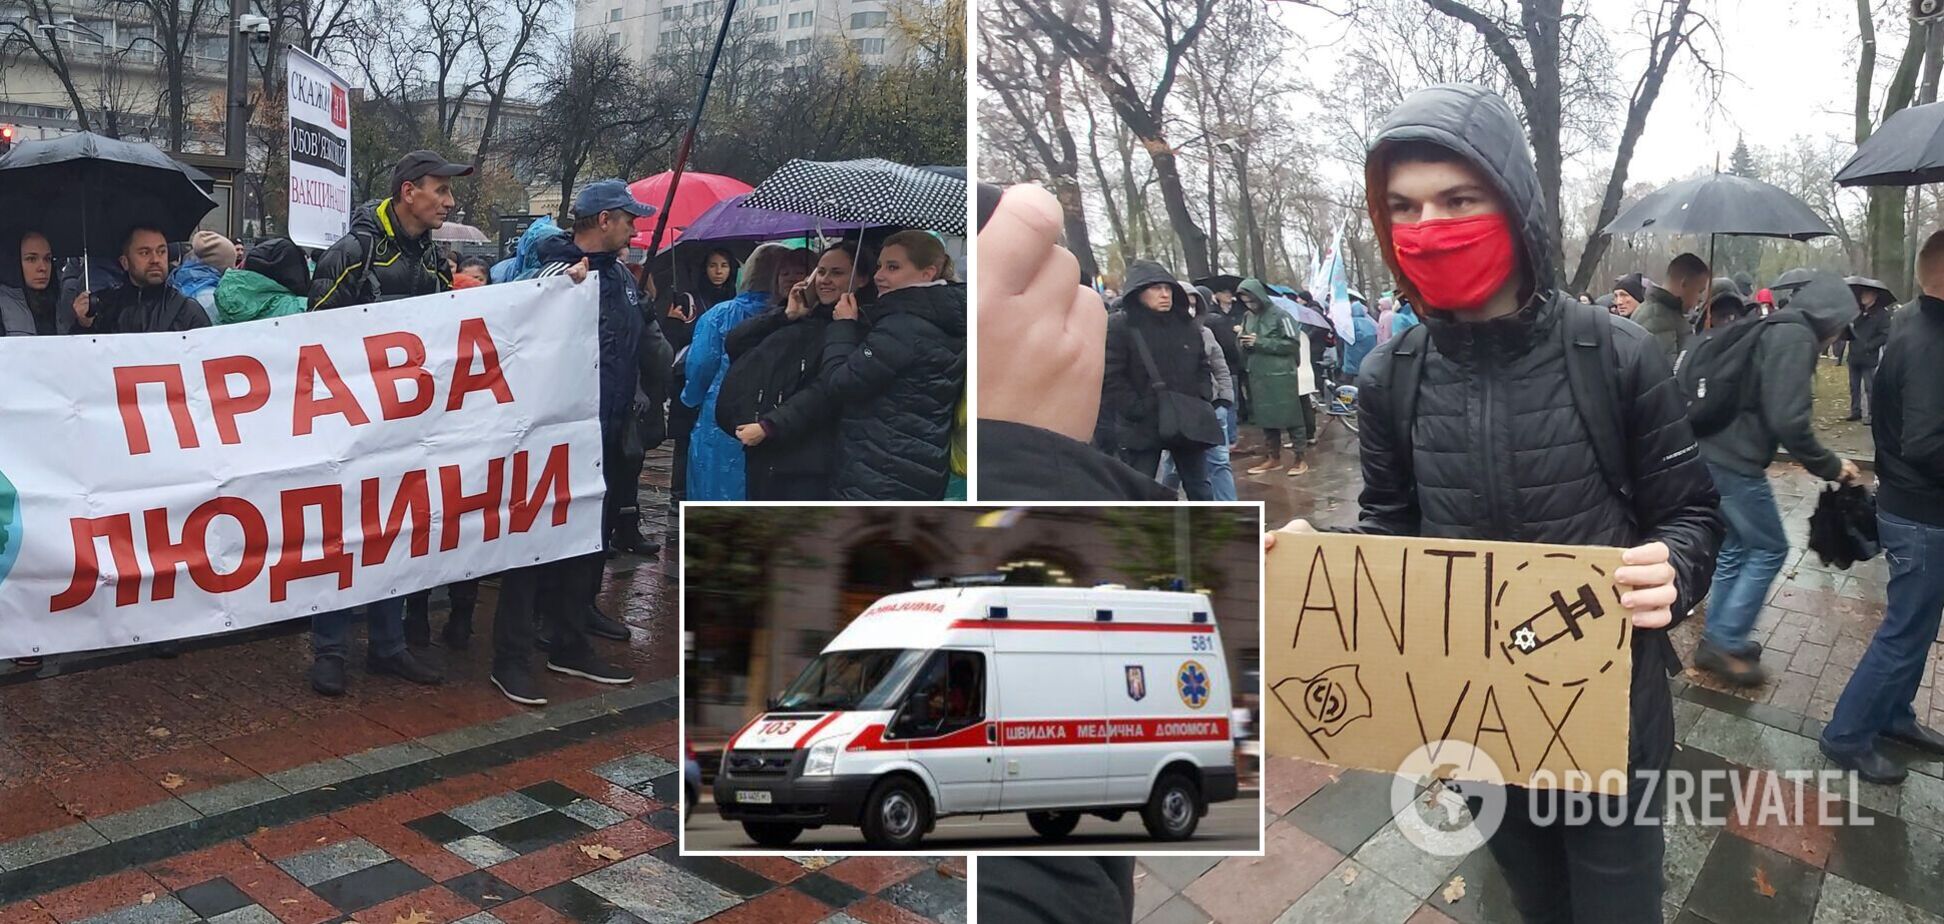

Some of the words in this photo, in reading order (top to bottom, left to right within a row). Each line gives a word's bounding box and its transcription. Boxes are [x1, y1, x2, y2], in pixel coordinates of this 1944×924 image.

[291, 71, 330, 113] СКАЖИ
[113, 317, 514, 455] ПРАВА
[50, 443, 571, 613] ЛЮДИНИ
[1292, 544, 1494, 660] ANTI
[1191, 635, 1213, 651] 581
[757, 721, 797, 735] 103
[1005, 725, 1067, 740] ШВИДКА
[1077, 723, 1144, 738] МЕДИЧНА
[1155, 722, 1220, 736] ДОПОМОГА
[1406, 672, 1583, 781] VAX
